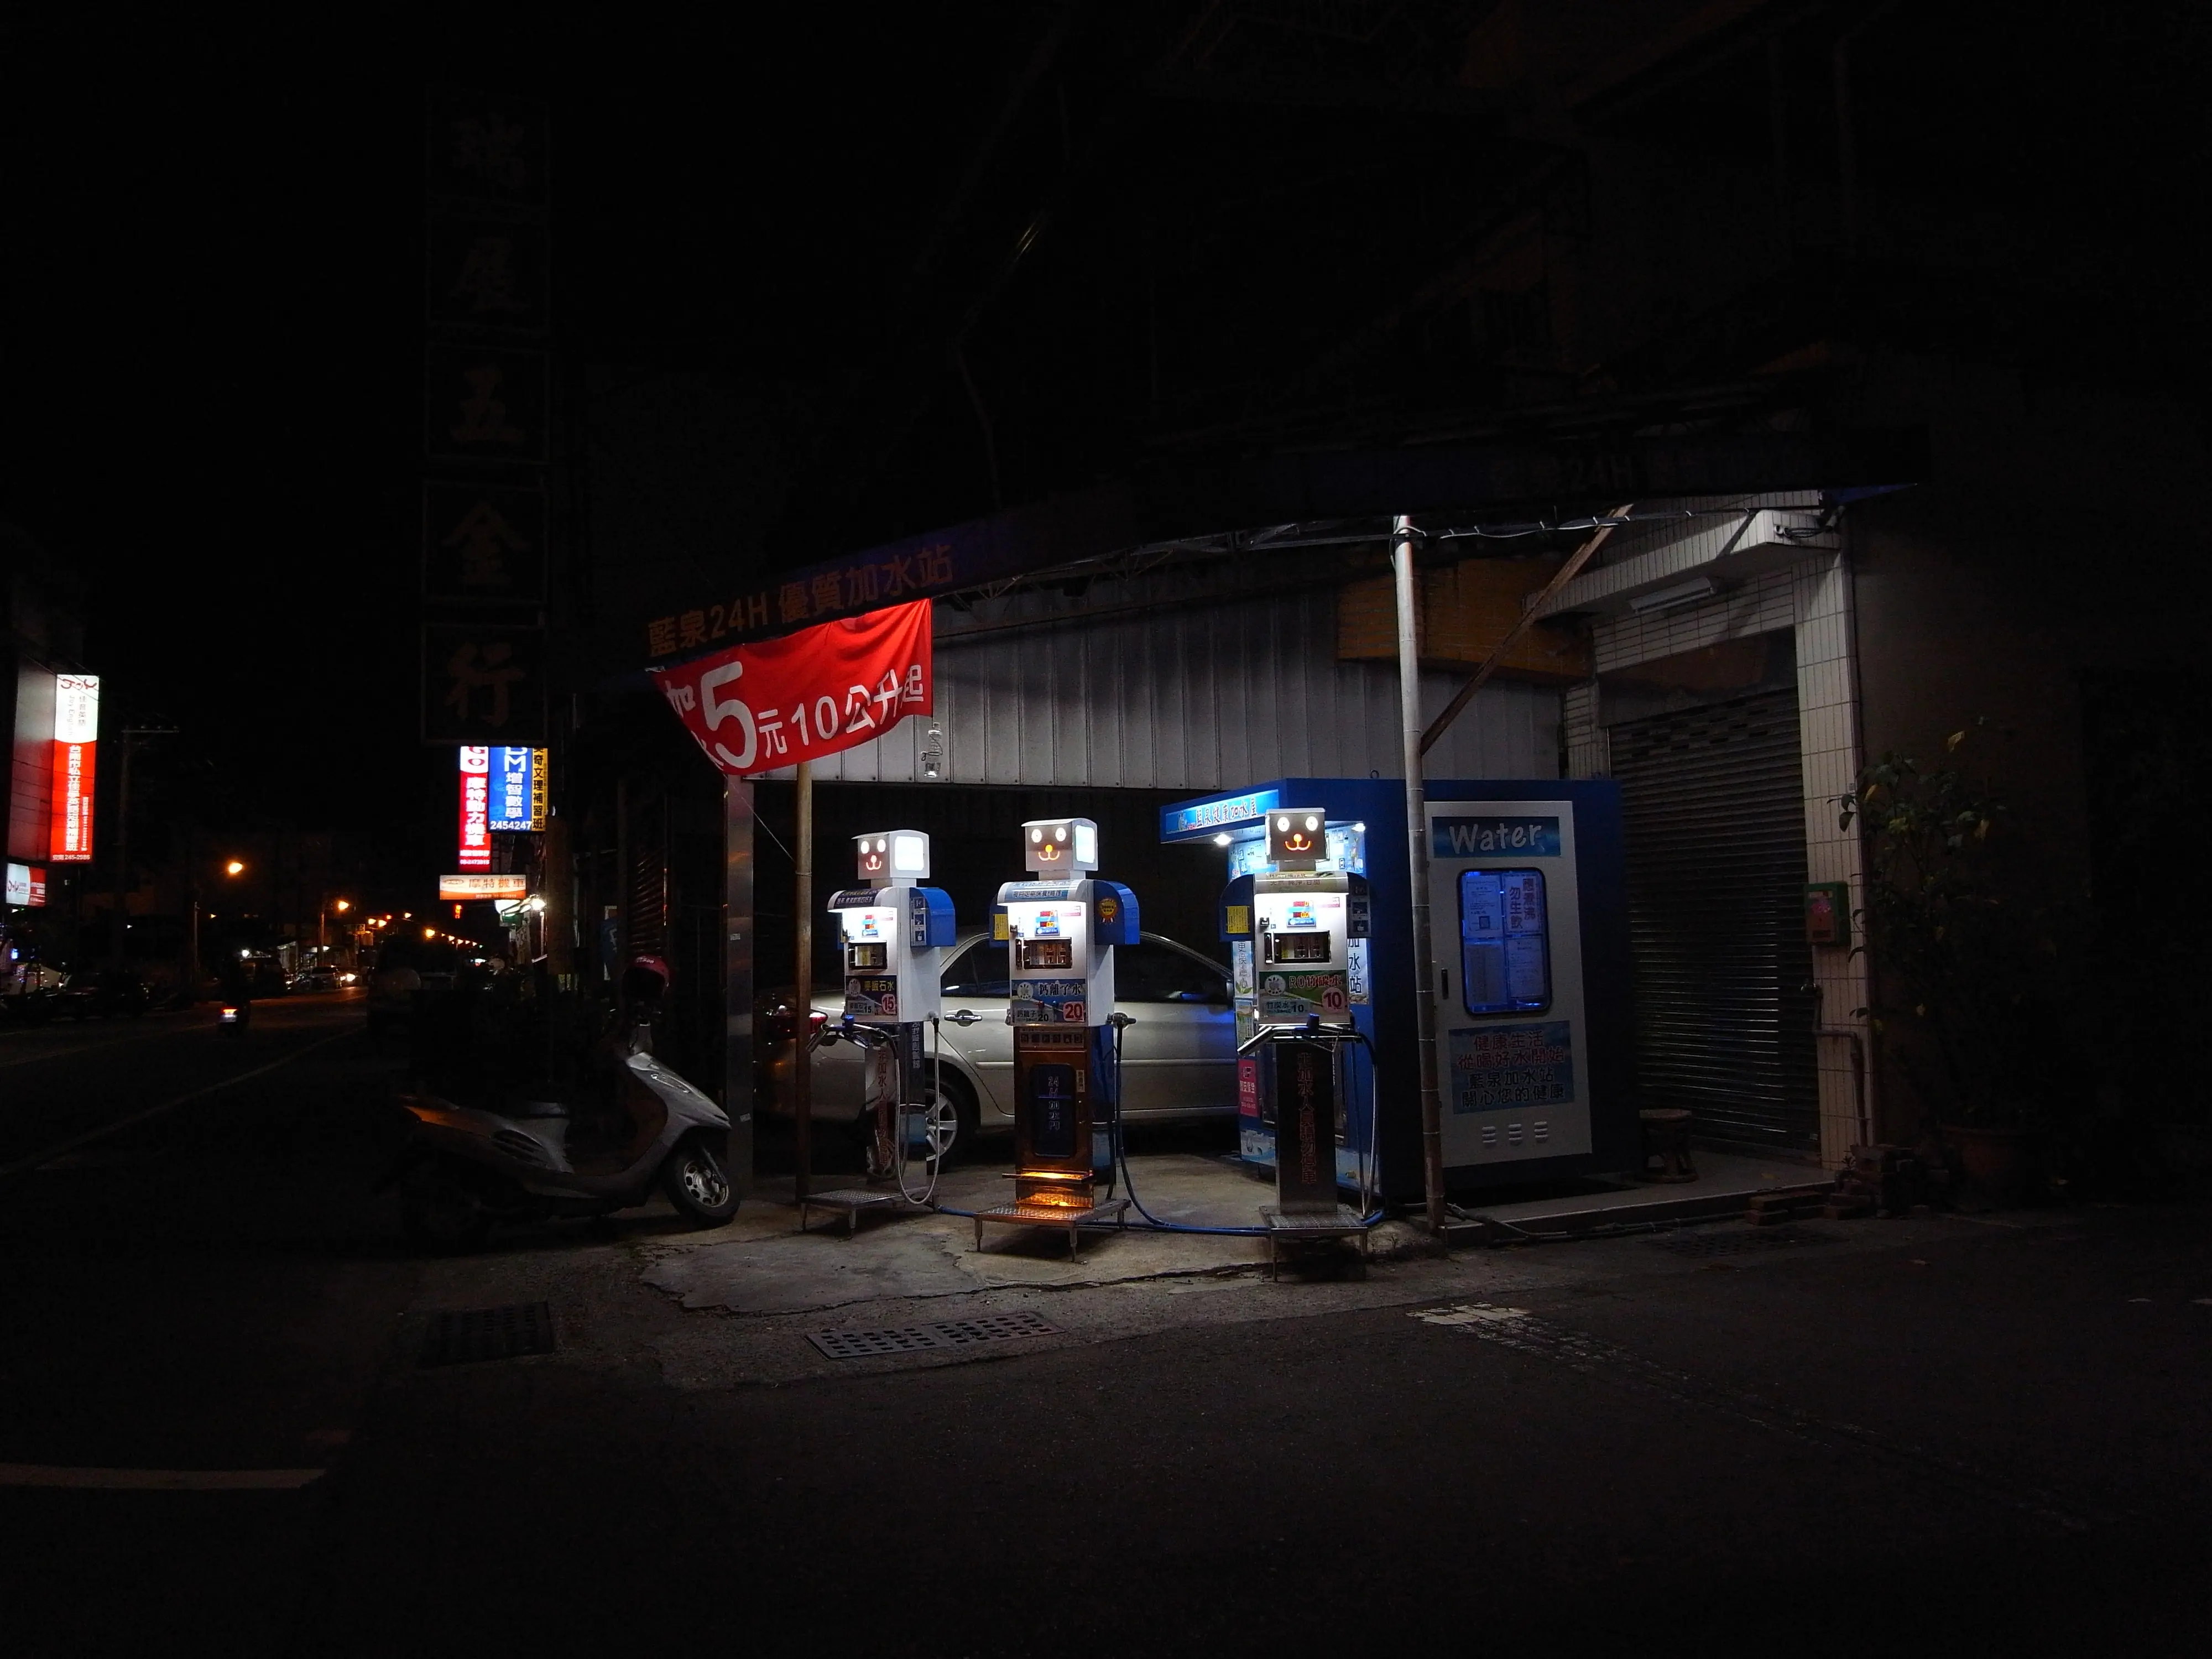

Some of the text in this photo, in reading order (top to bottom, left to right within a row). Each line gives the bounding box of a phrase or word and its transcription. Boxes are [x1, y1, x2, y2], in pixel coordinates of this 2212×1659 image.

[490, 821, 532, 830] 2454247
[1448, 821, 1542, 855] Water
[883, 996, 894, 1010] 15
[1292, 1004, 1304, 1013] 10
[1323, 992, 1342, 1008] 10
[1065, 1003, 1083, 1019] 20
[1473, 1030, 1544, 1052] 健康生活
[1458, 1046, 1565, 1072] 從喝好水開始
[1469, 1067, 1554, 1089] 藍泉加水站
[1462, 1083, 1564, 1108] 關心您的健康
